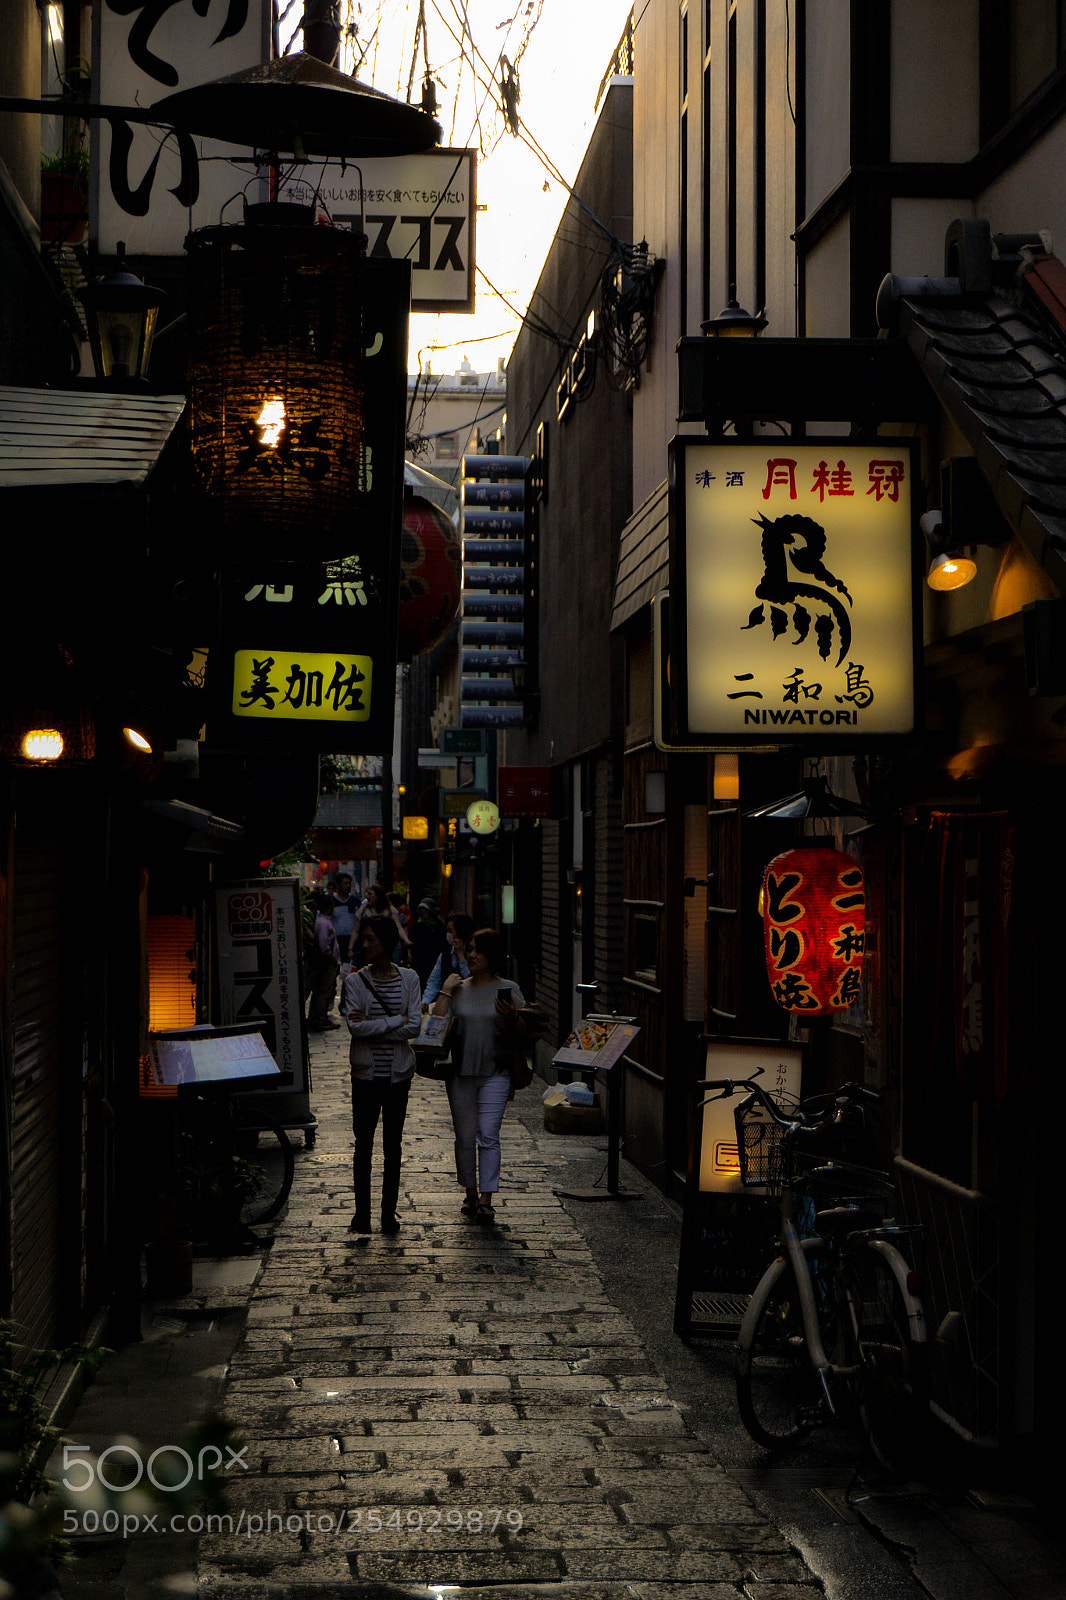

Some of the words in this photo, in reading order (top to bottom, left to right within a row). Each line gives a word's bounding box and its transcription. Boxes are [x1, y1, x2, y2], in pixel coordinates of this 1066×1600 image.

[695, 470, 745, 489] 清酒
[762, 458, 905, 503] 月桂冠
[239, 657, 365, 711] 美加佐
[727, 662, 874, 709] 二和鳥
[744, 709, 858, 726] NIWATORI
[766, 870, 823, 1010] とり焼
